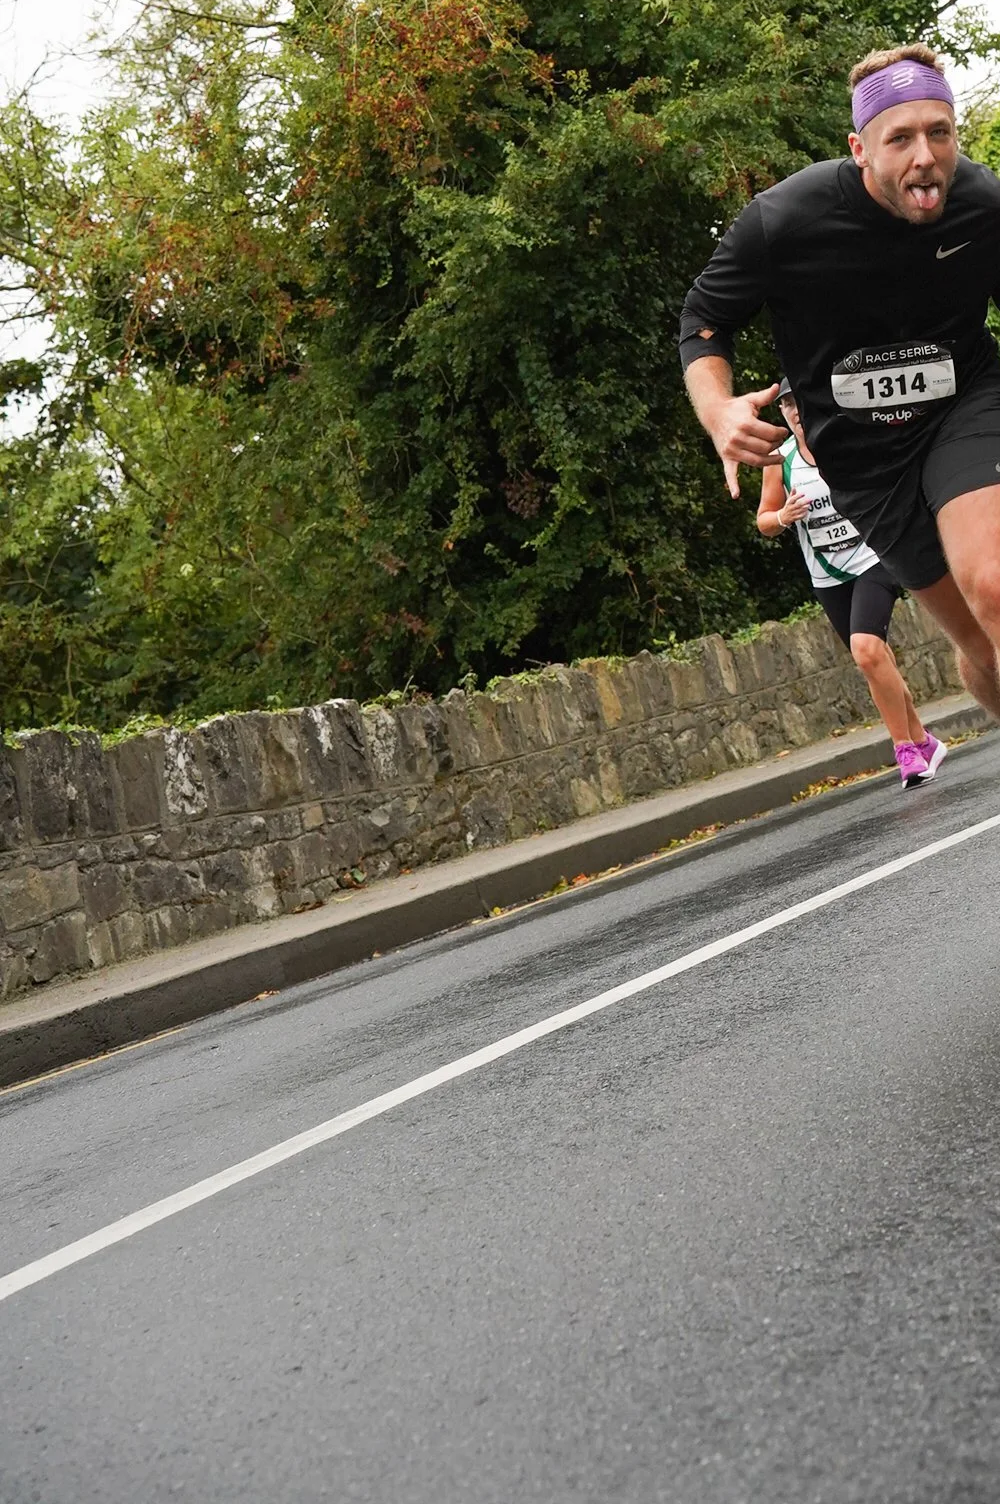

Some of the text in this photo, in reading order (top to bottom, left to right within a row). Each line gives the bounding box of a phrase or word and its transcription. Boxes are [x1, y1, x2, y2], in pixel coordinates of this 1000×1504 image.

[866, 344, 939, 364] RACE SERIES
[863, 372, 927, 400] 1314
[872, 412, 895, 424] Pop
[896, 409, 913, 421] Up
[821, 516, 836, 524] RACE
[826, 525, 848, 540] 128
